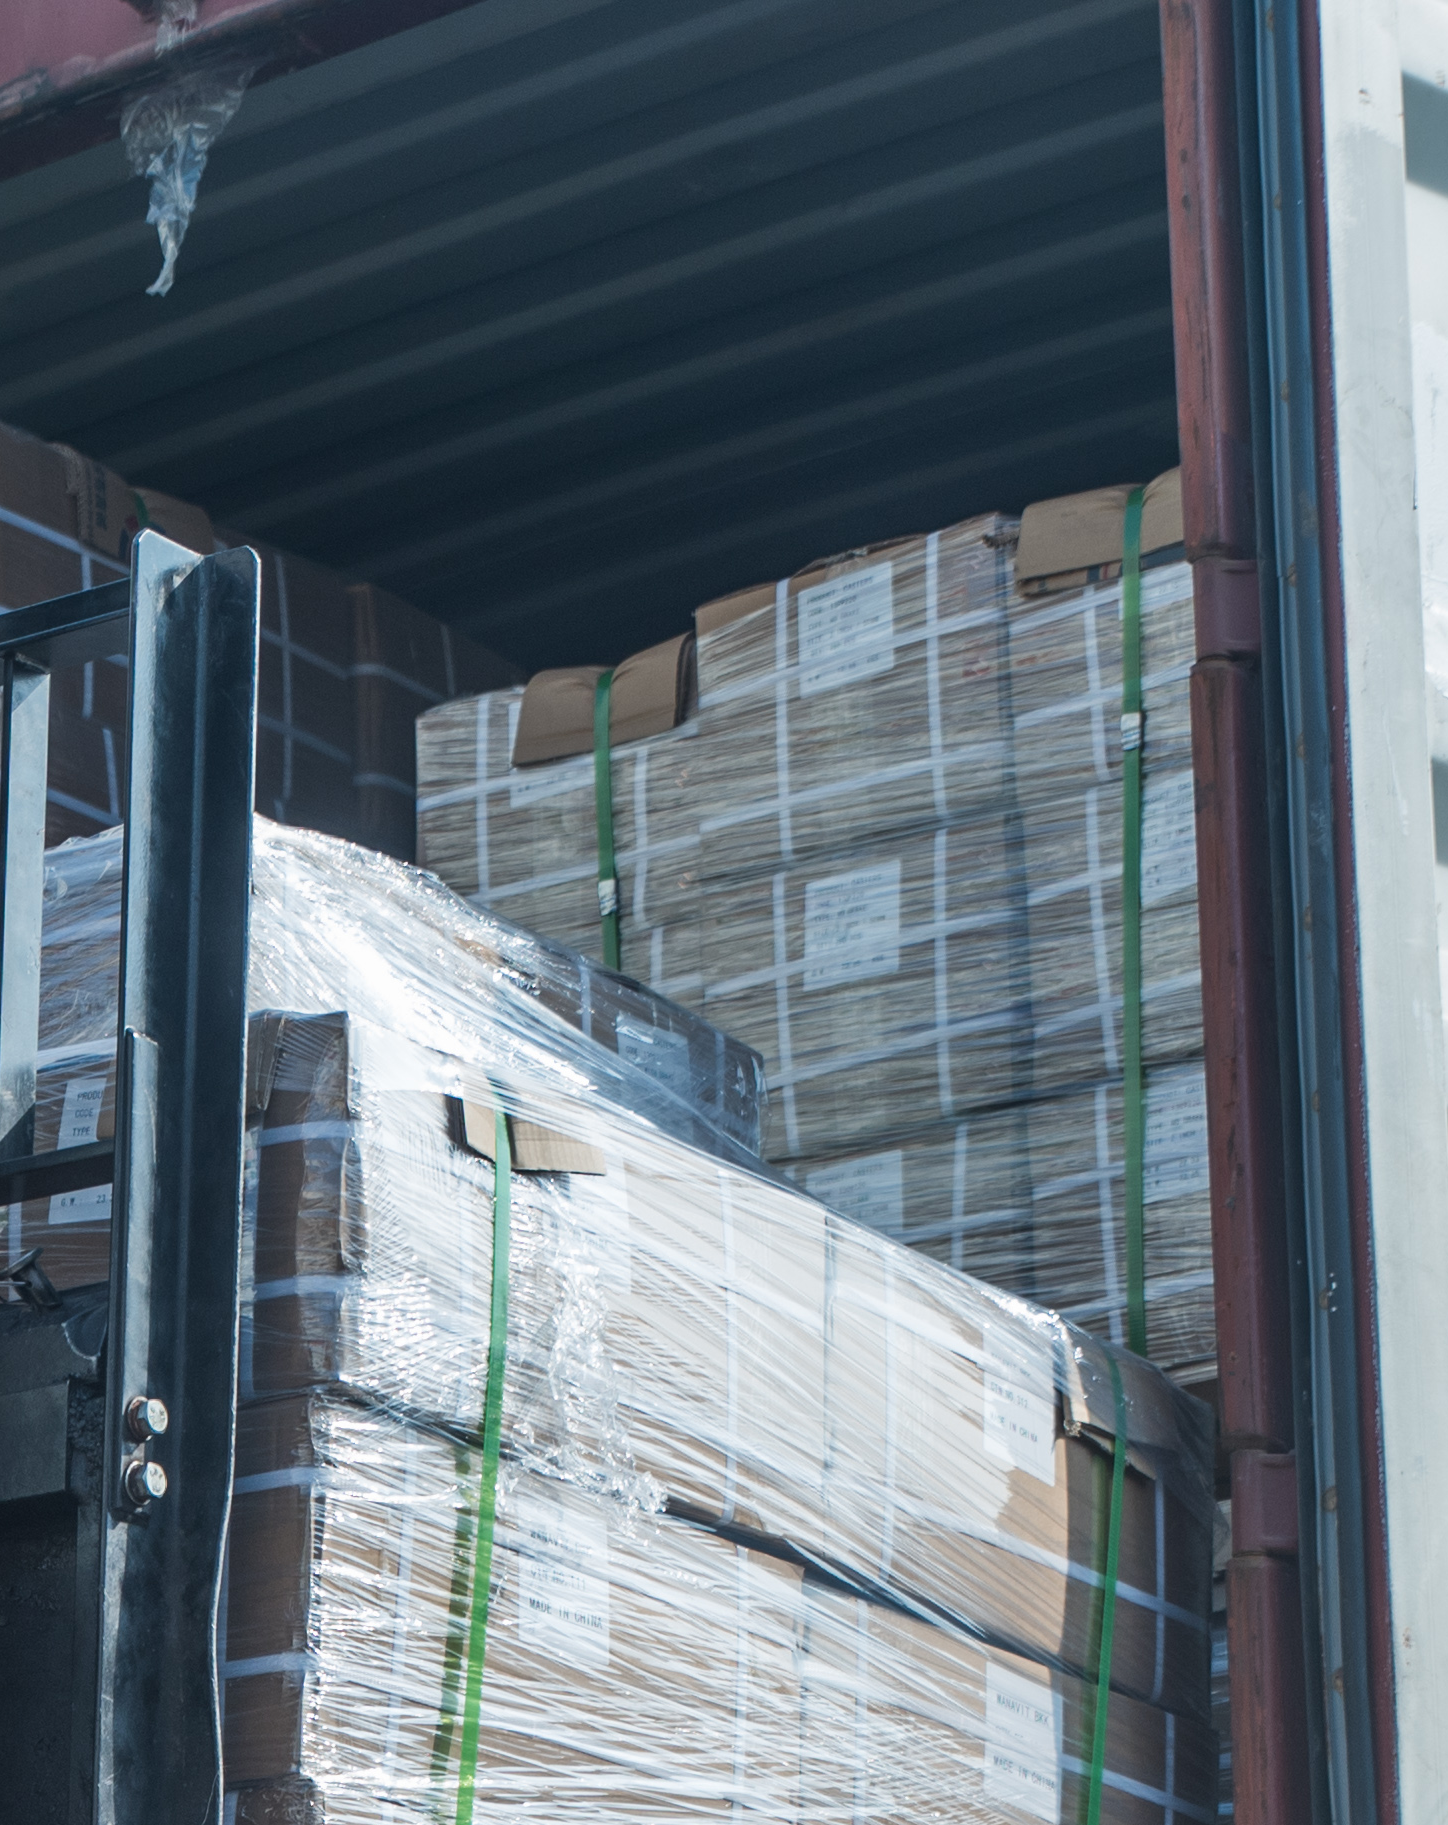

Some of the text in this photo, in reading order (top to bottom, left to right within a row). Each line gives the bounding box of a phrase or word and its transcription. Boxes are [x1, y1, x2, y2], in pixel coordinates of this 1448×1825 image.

[529, 1597, 603, 1629] MADE IN CHINA
[1018, 1765, 1028, 1780] IN
